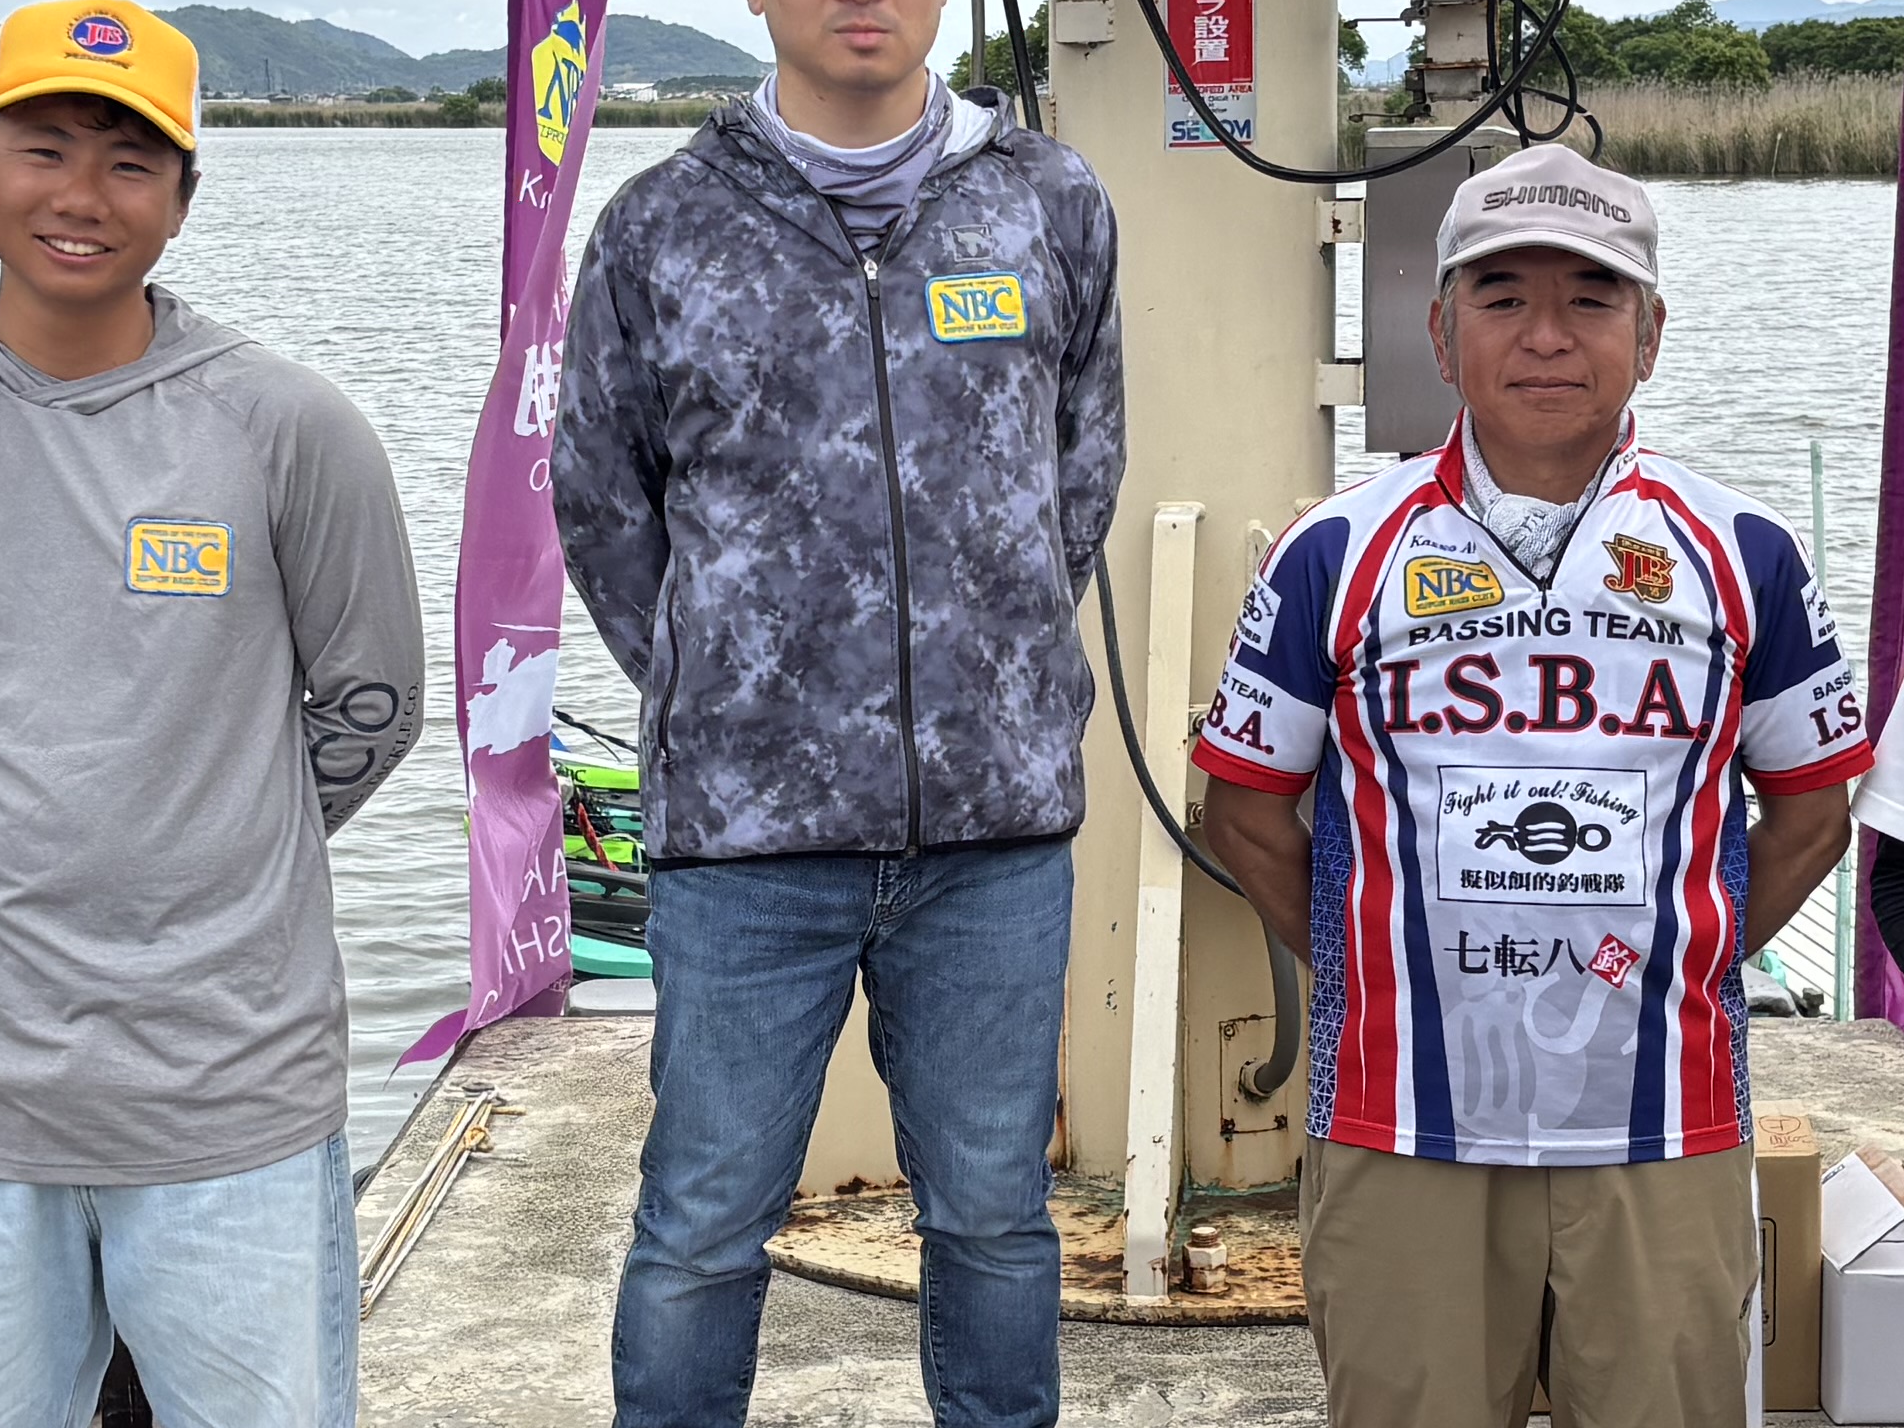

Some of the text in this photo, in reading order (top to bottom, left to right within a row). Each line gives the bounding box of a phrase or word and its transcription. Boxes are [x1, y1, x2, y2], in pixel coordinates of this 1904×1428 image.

[1482, 184, 1632, 223] SHIMANO
[939, 286, 1018, 324] NBC
[137, 538, 221, 576] NBC
[1603, 549, 1674, 594] JB
[1414, 568, 1495, 603] NBC
[1408, 607, 1685, 647] BASSING TEAM
[1231, 677, 1273, 709] TEAM
[1379, 652, 1710, 740] I.S.B.A.
[1443, 781, 1498, 817] Fight
[1570, 781, 1641, 826] Fishing
